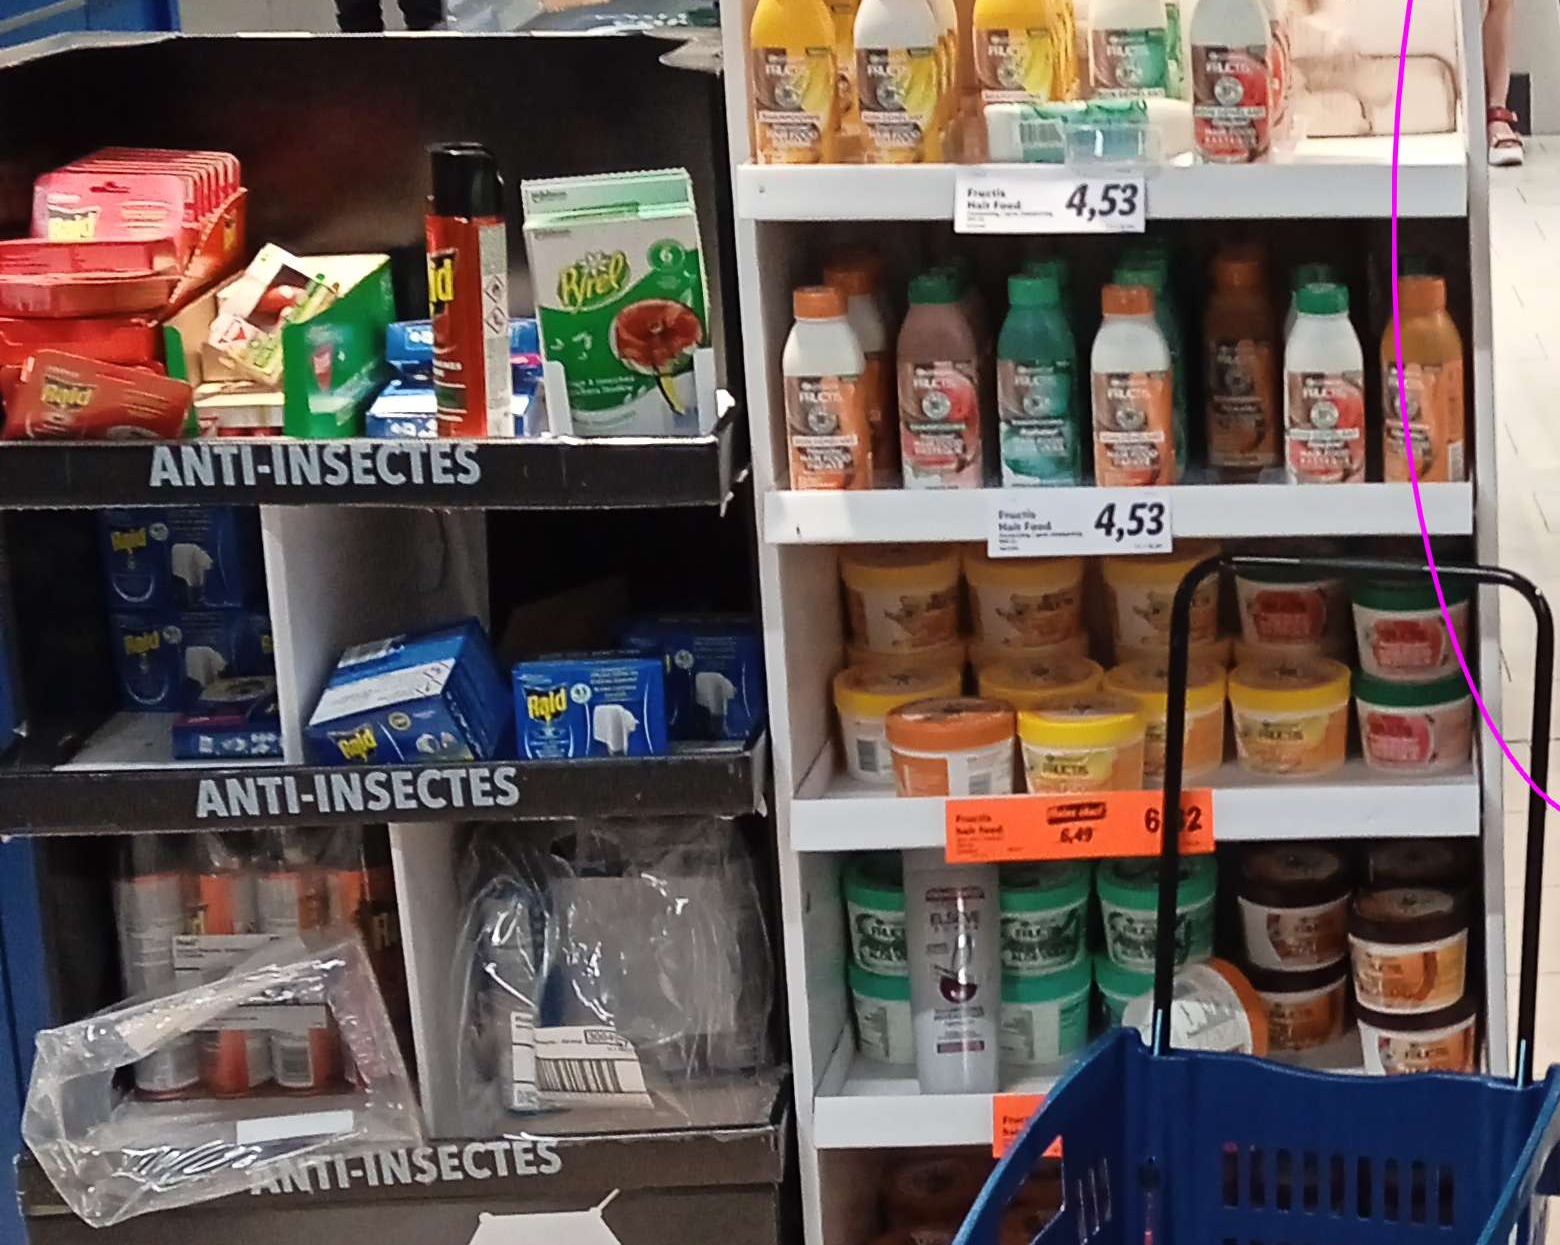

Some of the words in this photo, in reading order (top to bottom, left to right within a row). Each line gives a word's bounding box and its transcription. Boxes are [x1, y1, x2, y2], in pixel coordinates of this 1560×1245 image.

[1065, 182, 1139, 221] 4,53
[150, 443, 482, 487] ANTI-INSECTES
[1094, 503, 1166, 541] 4,53
[527, 689, 568, 724] Raid
[337, 726, 377, 762] Raid
[196, 766, 520, 818] ANTI-INSECTES
[250, 1141, 564, 1196] ANTI-INSECTES
